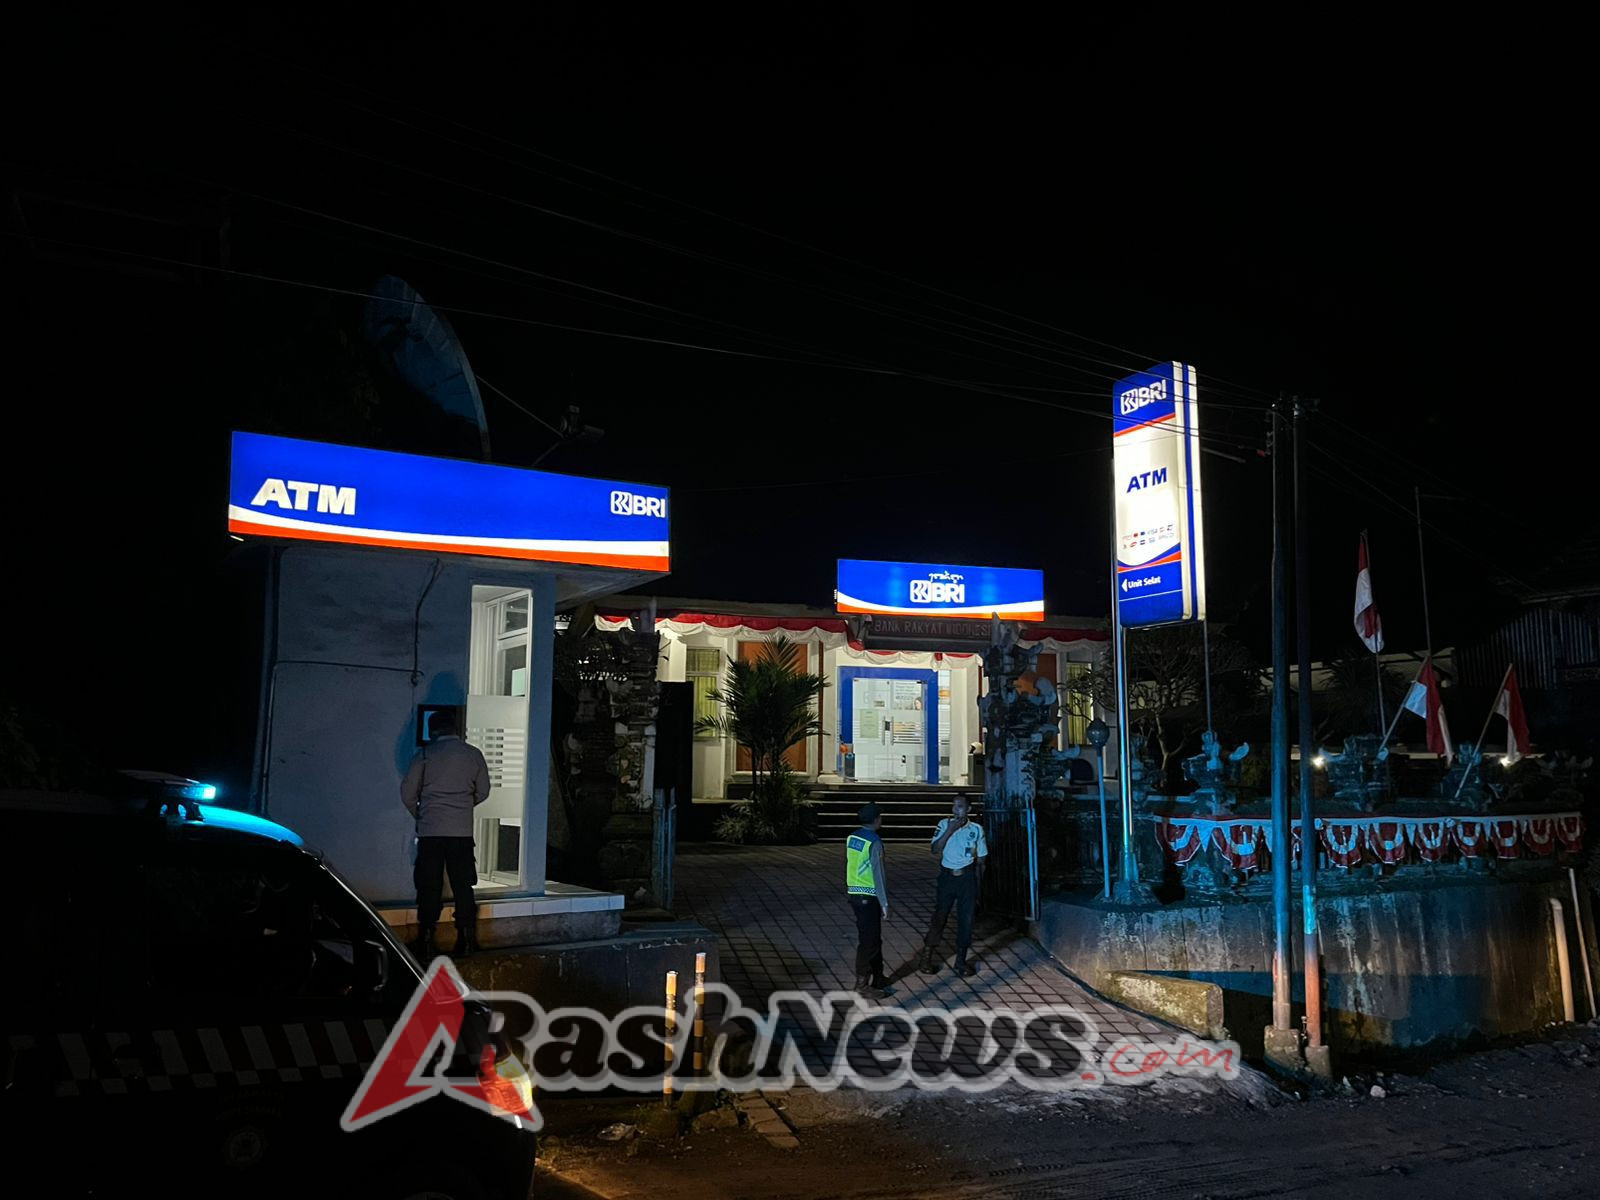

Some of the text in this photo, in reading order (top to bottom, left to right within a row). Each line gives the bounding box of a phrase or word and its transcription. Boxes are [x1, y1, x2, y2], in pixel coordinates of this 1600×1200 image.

[1127, 467, 1168, 494] ATM
[250, 478, 357, 515] ATM
[633, 496, 666, 518] BRI
[932, 582, 965, 603] BRI
[1128, 579, 1143, 588] Unit
[874, 620, 901, 633] BANK
[904, 621, 943, 634] RAKYAT
